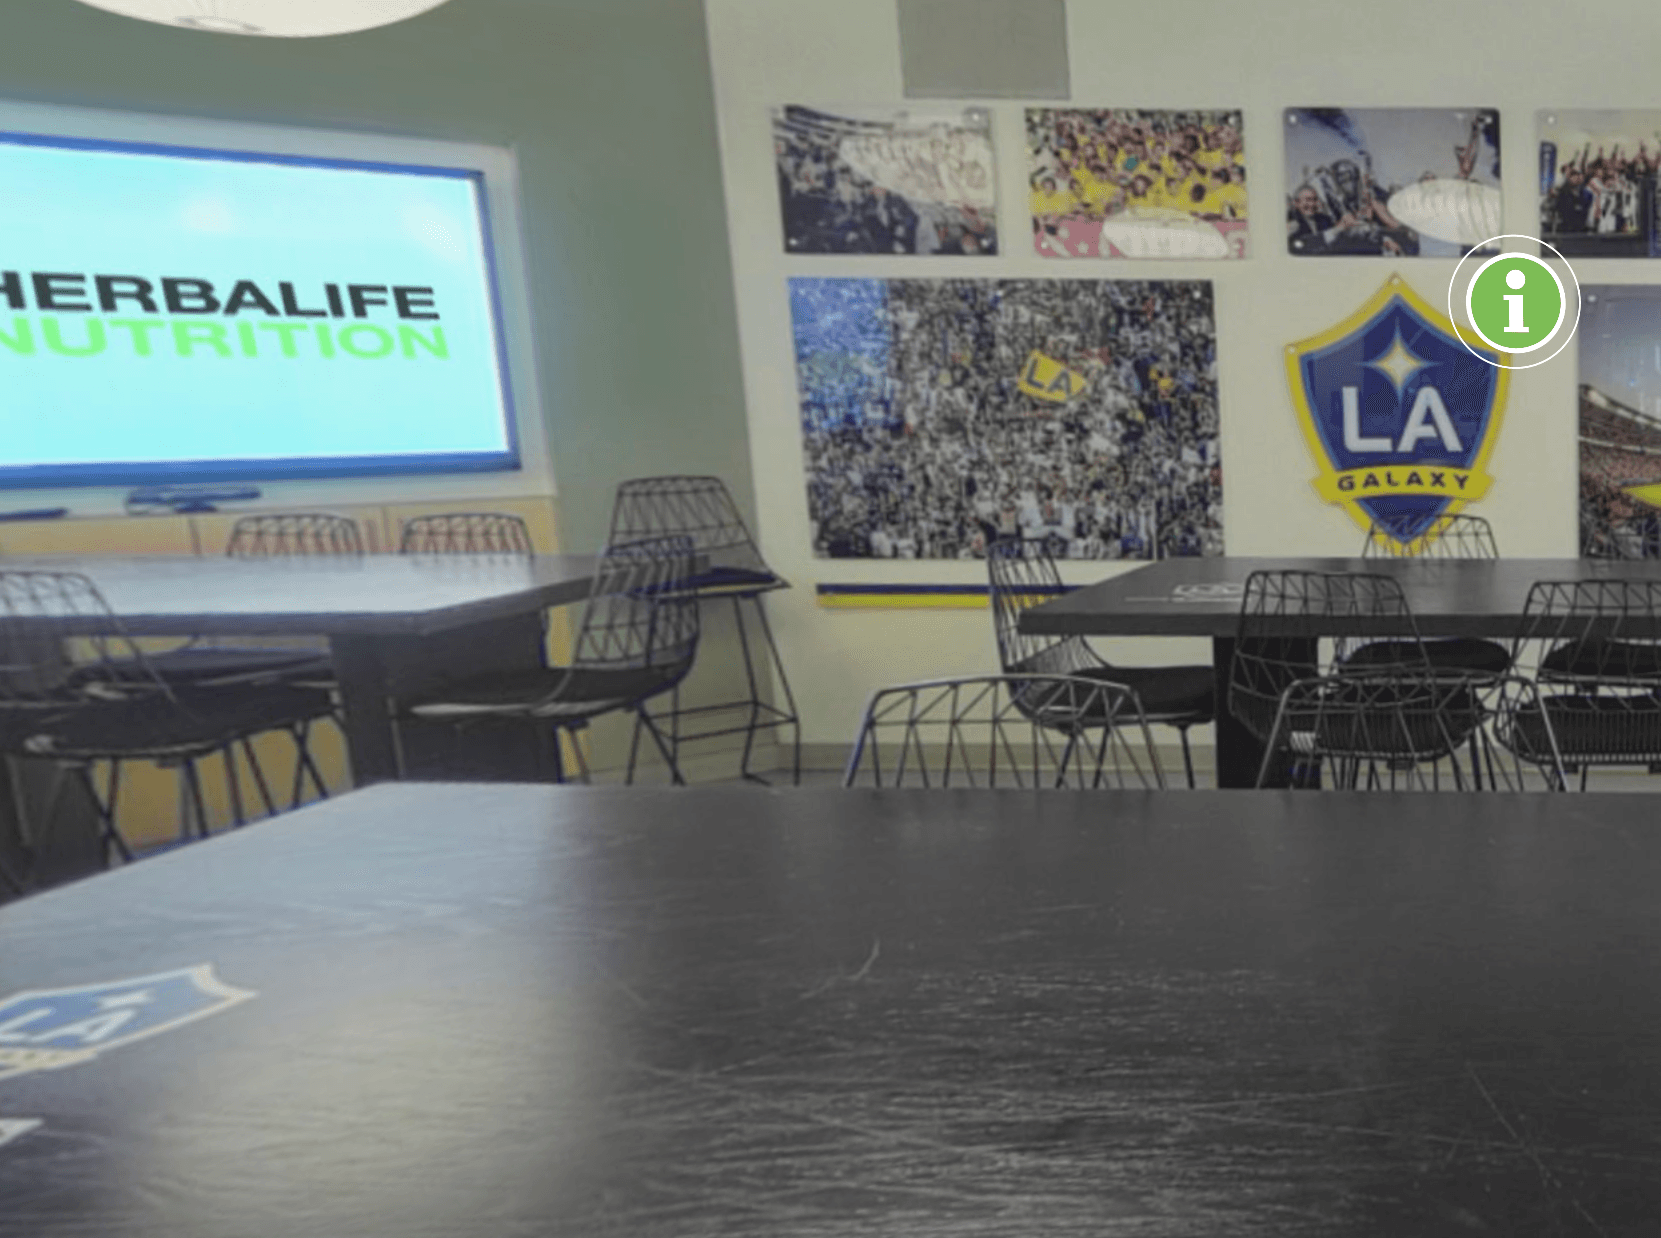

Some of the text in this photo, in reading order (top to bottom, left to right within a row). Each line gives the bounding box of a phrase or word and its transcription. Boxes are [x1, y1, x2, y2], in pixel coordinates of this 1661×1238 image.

[1026, 358, 1071, 394] LA
[1342, 386, 1463, 452] LA
[1337, 471, 1470, 492] GALAXY
